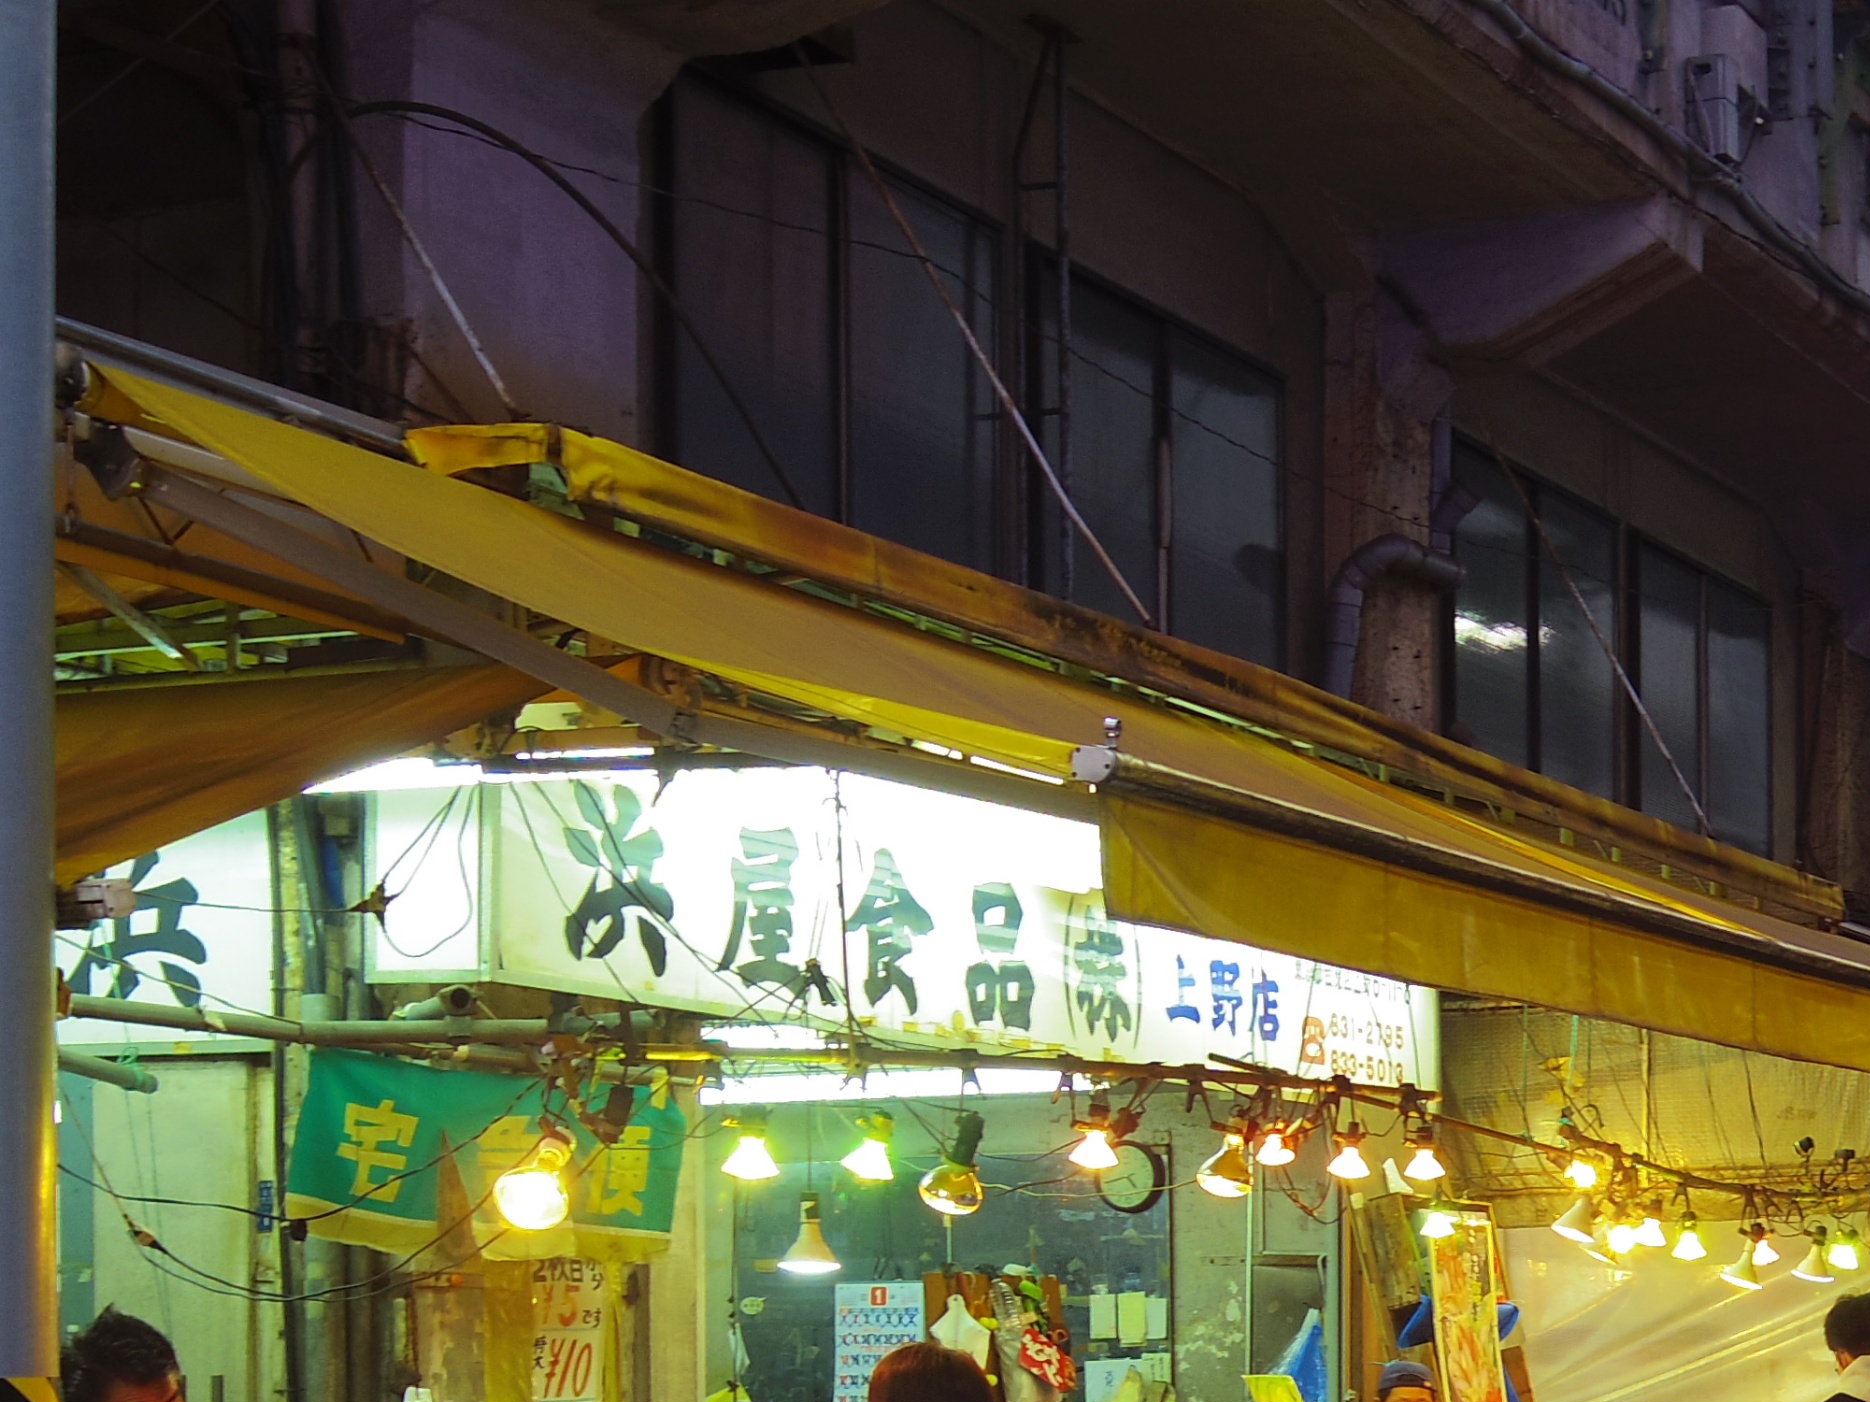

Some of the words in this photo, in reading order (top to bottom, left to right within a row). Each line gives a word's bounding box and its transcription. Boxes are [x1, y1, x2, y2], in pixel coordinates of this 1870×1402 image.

[1165, 954, 1280, 1043] 上野店
[543, 1337, 593, 1399] ¥10
